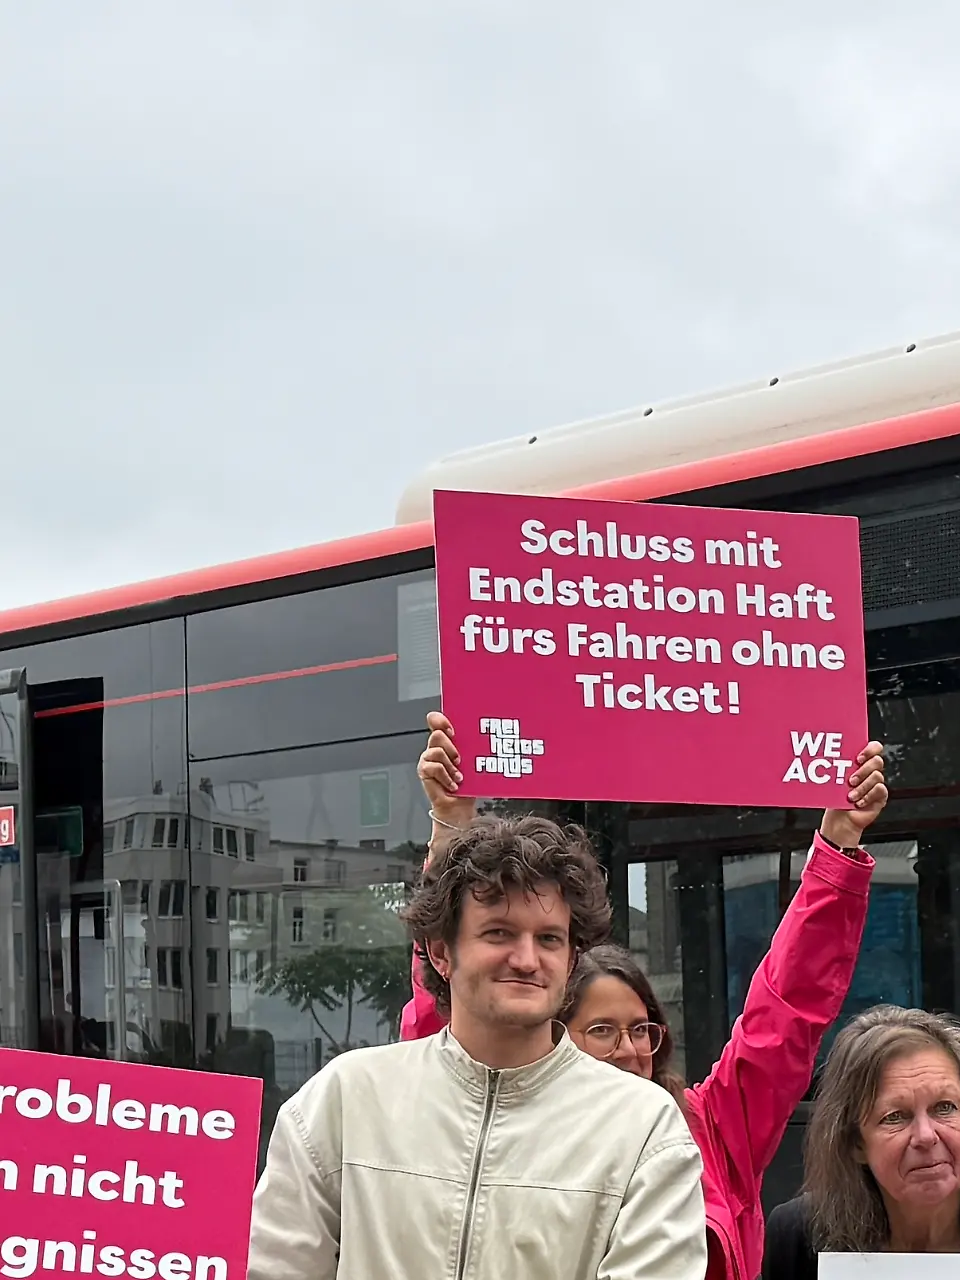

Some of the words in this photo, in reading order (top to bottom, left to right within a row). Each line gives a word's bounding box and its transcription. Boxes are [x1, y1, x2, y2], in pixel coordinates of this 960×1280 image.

[520, 519, 695, 563] Schluss
[705, 530, 783, 569] mit
[469, 567, 725, 615] Endstation
[736, 582, 836, 621] Haft
[459, 614, 557, 656] fürs
[567, 622, 722, 664] Fahren
[731, 630, 846, 671] ohne
[575, 671, 740, 714] Ticket!
[790, 730, 843, 758] WE
[0, 1078, 236, 1140] robleme
[32, 1154, 185, 1209] nicht
